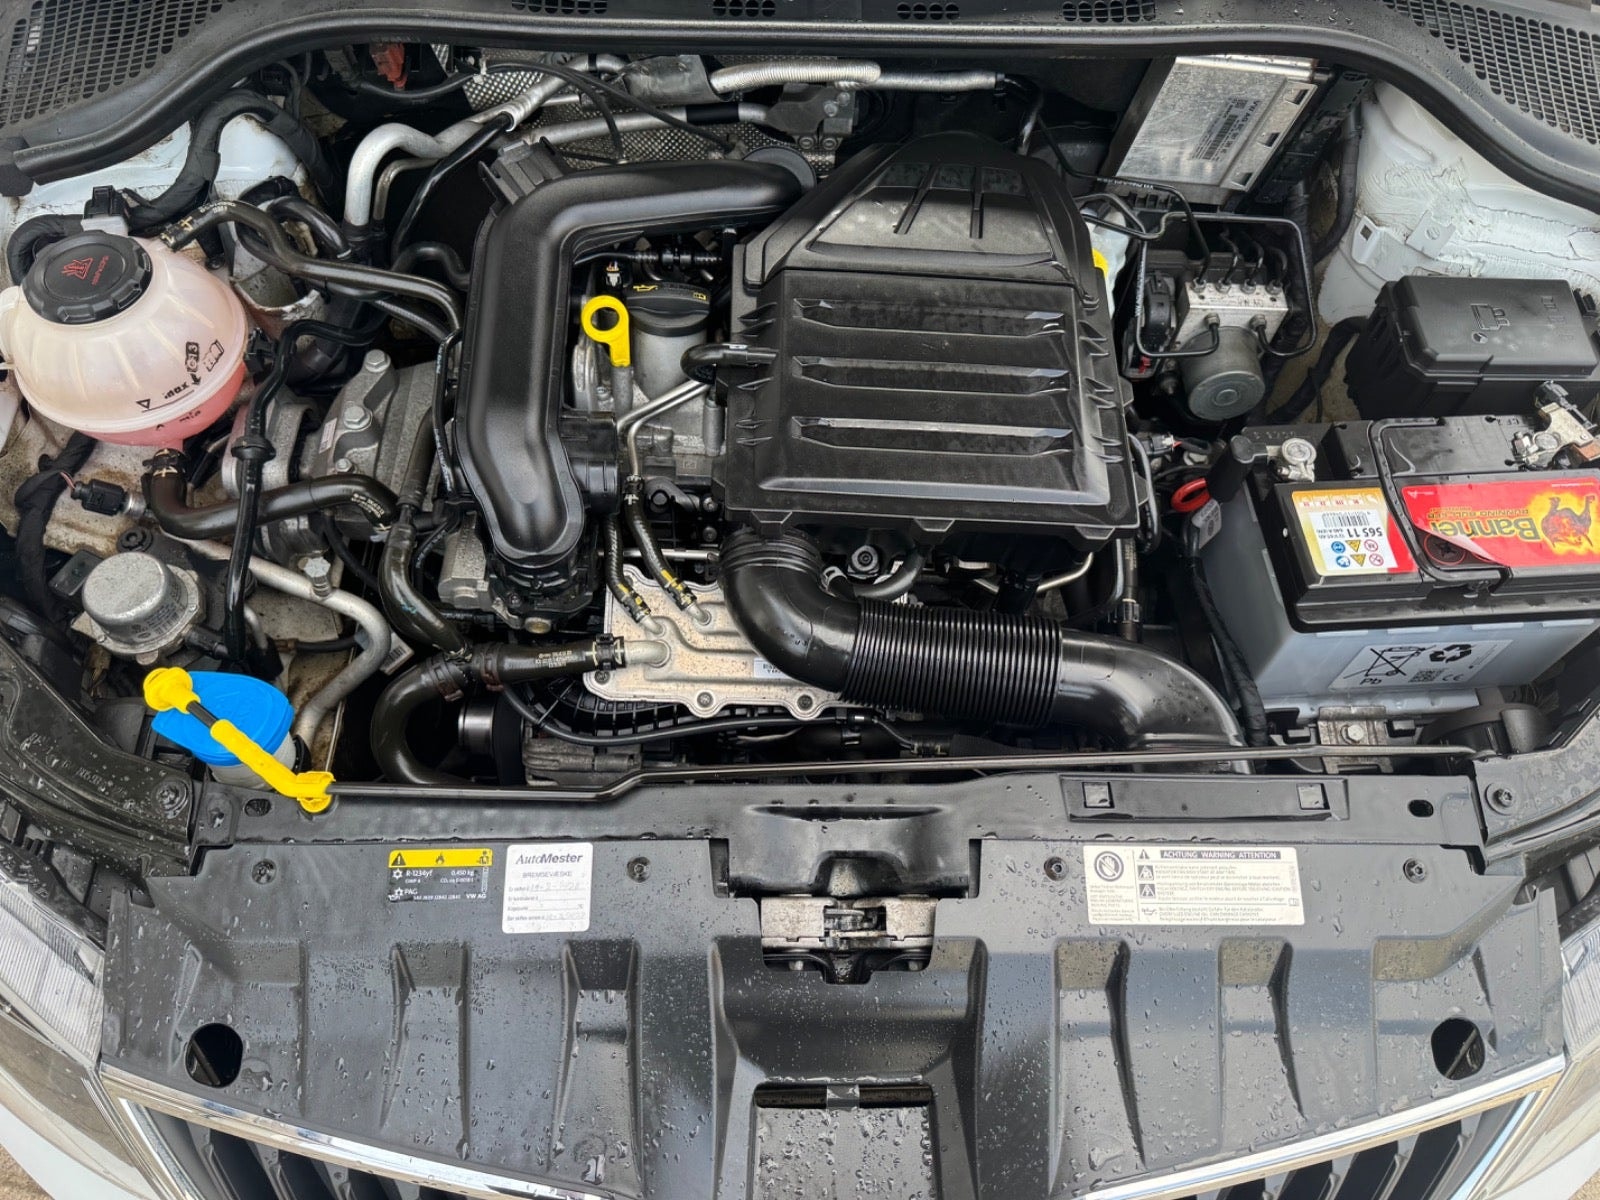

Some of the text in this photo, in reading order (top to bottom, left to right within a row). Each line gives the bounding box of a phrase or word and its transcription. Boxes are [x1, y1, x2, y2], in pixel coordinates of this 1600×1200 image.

[1346, 527, 1383, 538] 565 11
[1360, 678, 1382, 686] Pb
[515, 853, 584, 865] AutoMester
[1162, 850, 1278, 859] ACHTUNG WARNING ATTENTION
